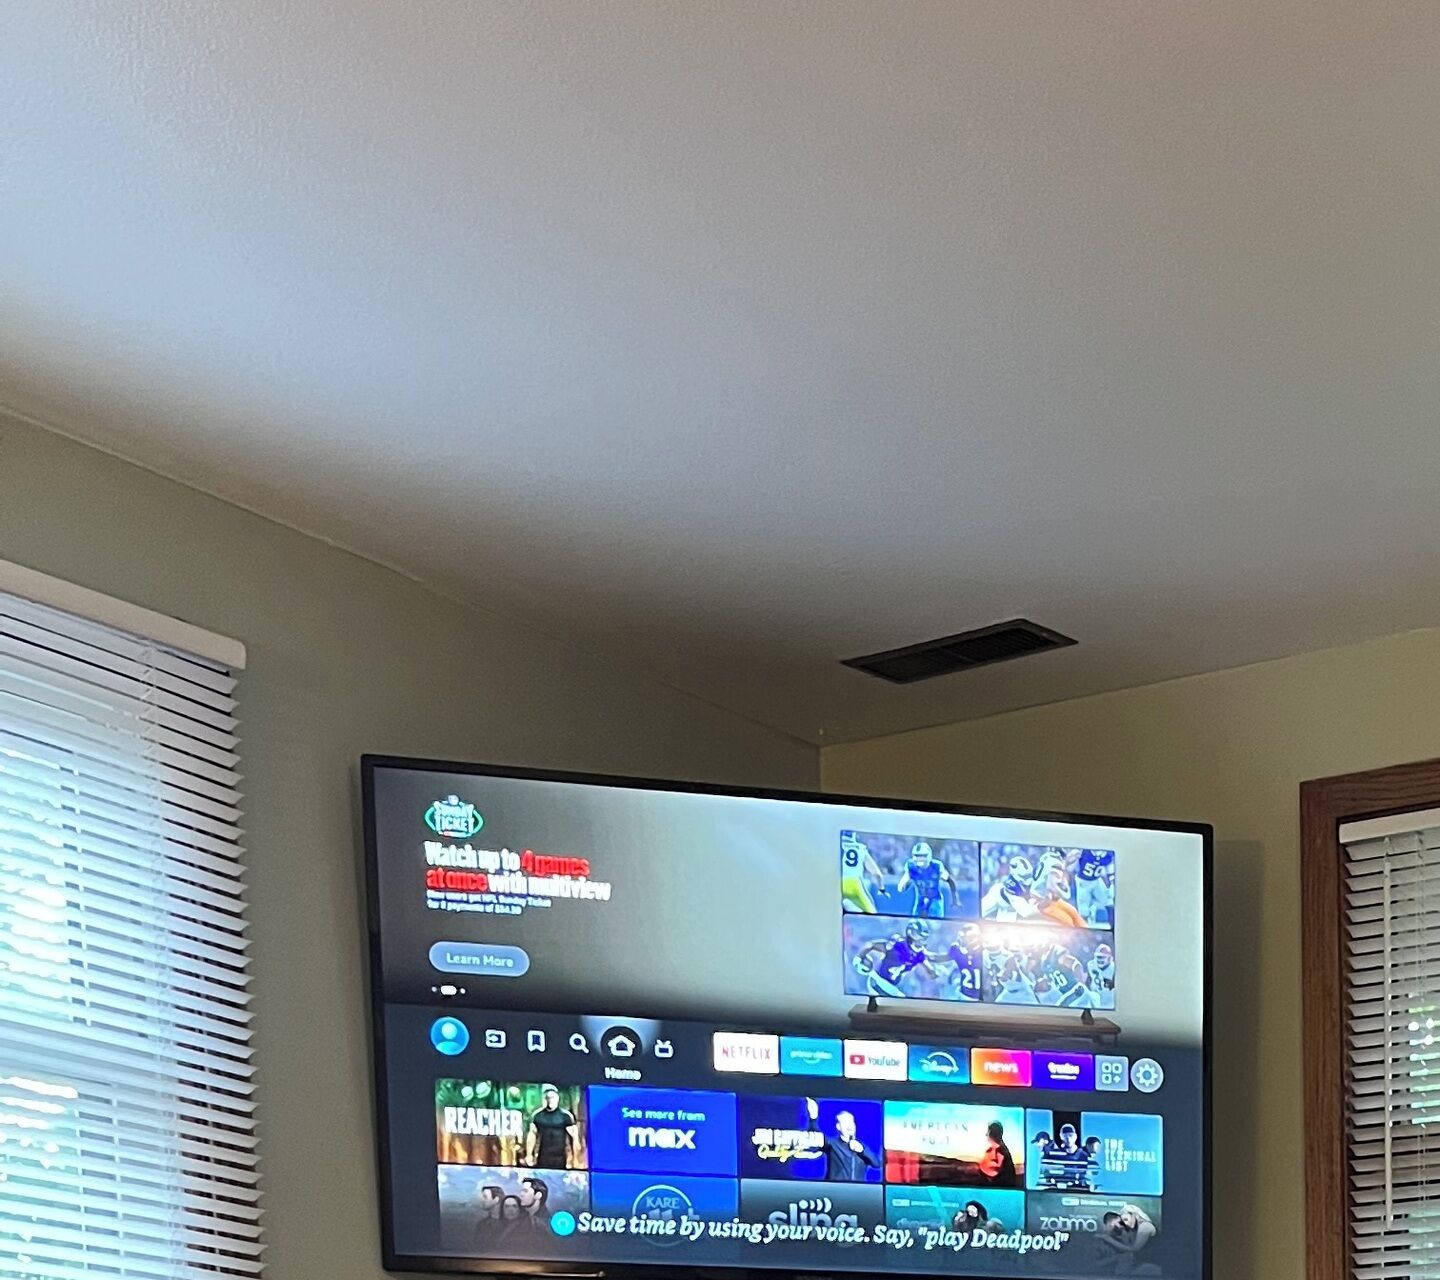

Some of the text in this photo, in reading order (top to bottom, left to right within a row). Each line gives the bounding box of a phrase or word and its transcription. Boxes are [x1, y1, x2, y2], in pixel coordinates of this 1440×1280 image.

[434, 814, 475, 832] TICKET
[424, 841, 590, 876] Watch up to 4 games
[426, 868, 611, 900] at once with multiview
[446, 952, 514, 968] Learn More
[722, 1046, 771, 1060] NETFLIX
[867, 1055, 901, 1067] YouTube
[983, 1060, 1019, 1074] news
[604, 1066, 642, 1081] Home
[444, 1106, 524, 1138] REACHER
[621, 1107, 706, 1122] See more from
[628, 1126, 696, 1149] max
[1104, 1138, 1124, 1150] THE
[1105, 1149, 1157, 1163] TERMINAL
[1105, 1160, 1128, 1172] LIST
[645, 1195, 680, 1210] KARE
[577, 1211, 625, 1235] Save
[628, 1213, 677, 1236] time
[679, 1215, 706, 1242] by
[708, 1217, 763, 1243] using
[762, 1223, 813, 1245] your
[816, 1223, 870, 1243] voice.
[873, 1225, 915, 1249] Say,
[918, 1225, 969, 1252] "play
[970, 1228, 1070, 1254] Deadpool"
